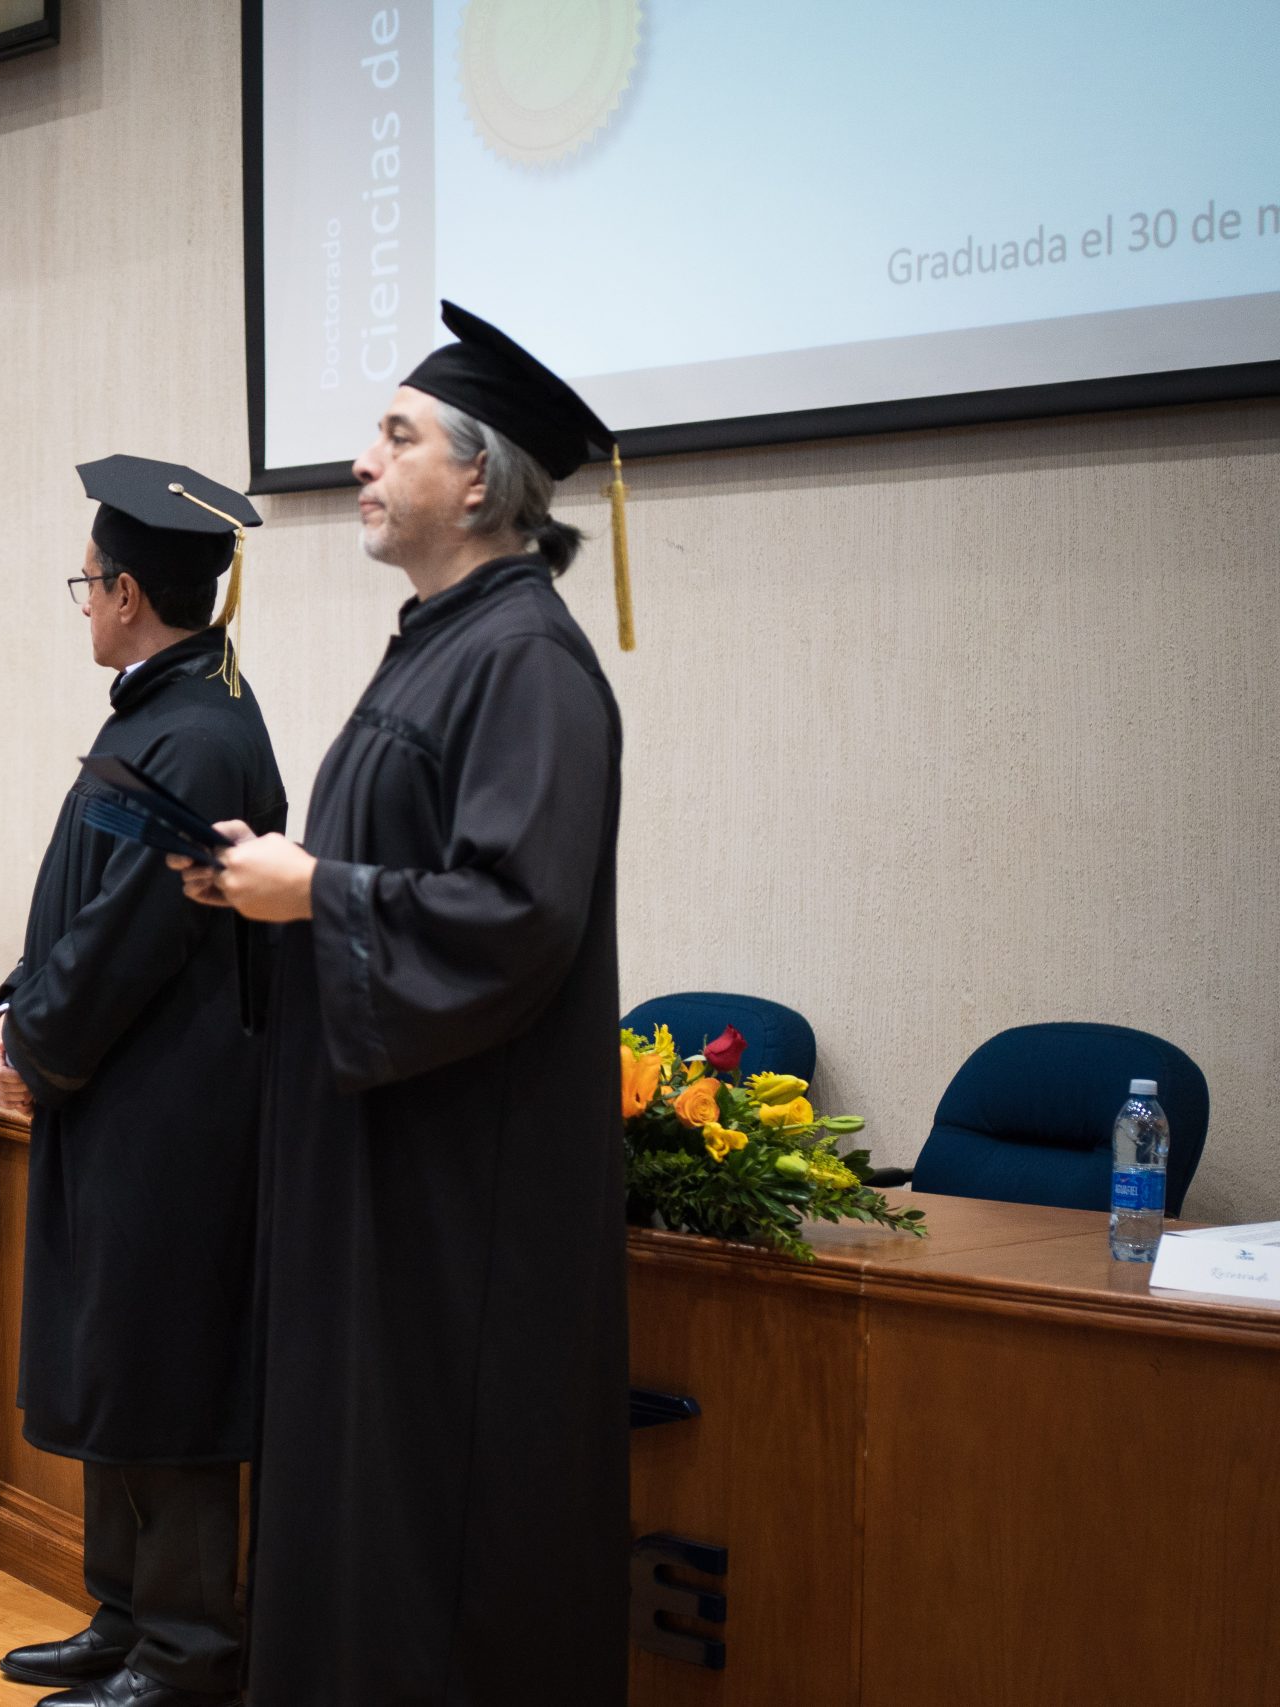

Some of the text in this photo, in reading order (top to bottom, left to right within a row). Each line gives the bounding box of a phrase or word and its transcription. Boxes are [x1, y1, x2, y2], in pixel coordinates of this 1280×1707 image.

[360, 7, 401, 383] Ciencias de
[887, 224, 1068, 286] Graduada
[1080, 213, 1114, 259] el
[1127, 207, 1178, 253] 30
[1191, 199, 1242, 244] de
[320, 217, 342, 391] Doctorado
